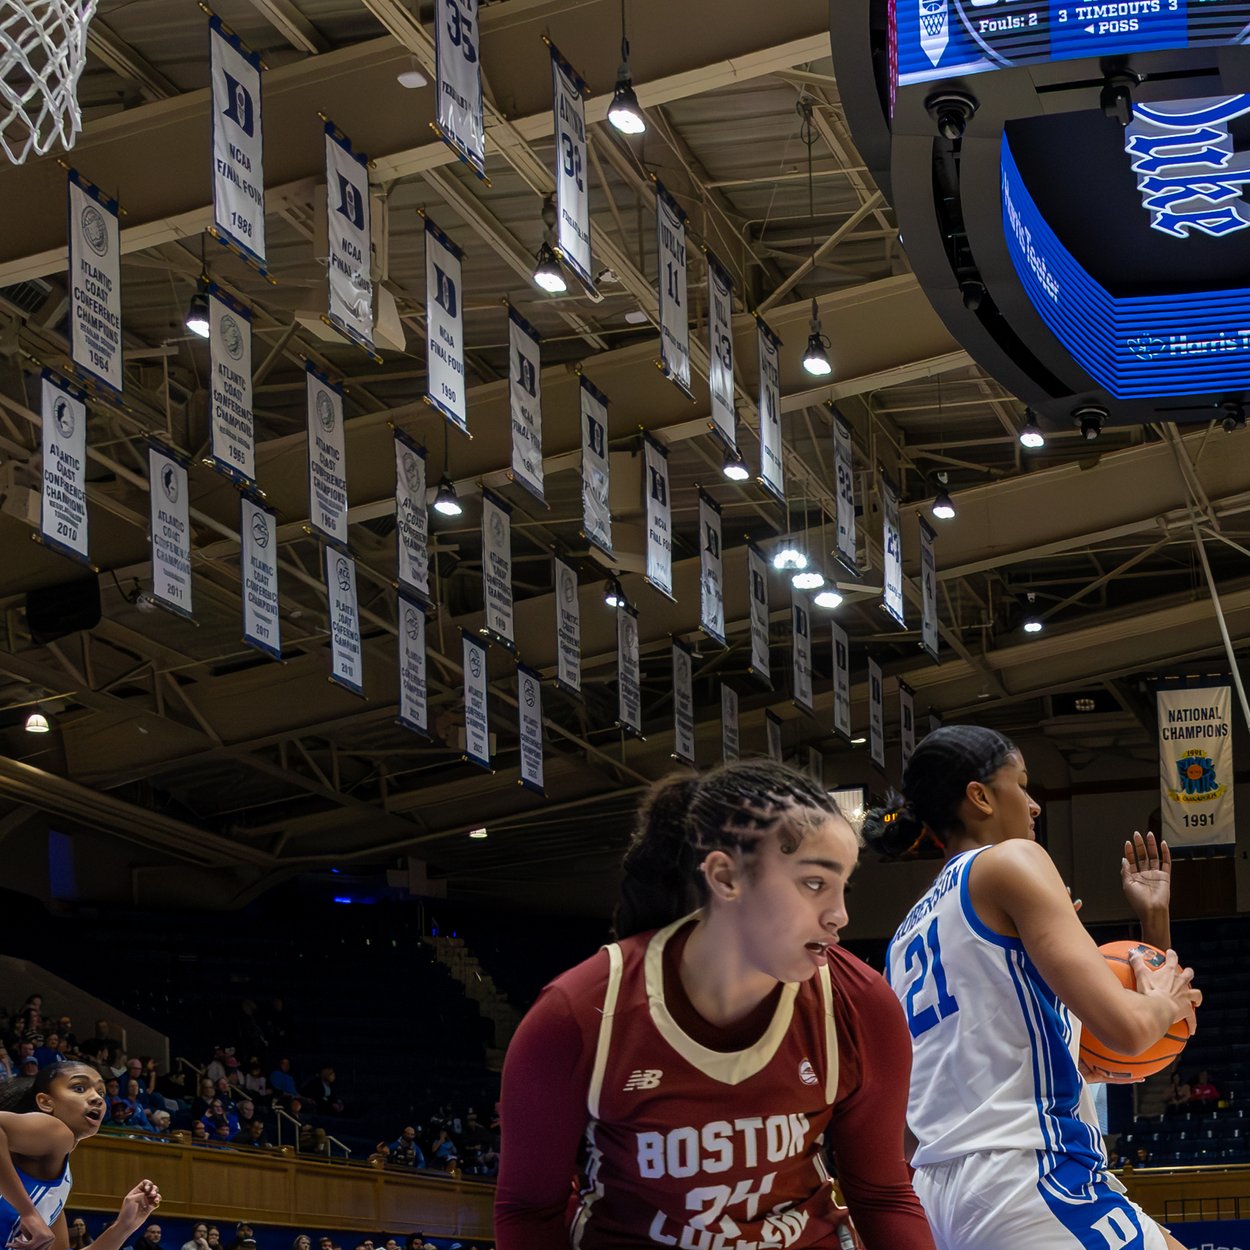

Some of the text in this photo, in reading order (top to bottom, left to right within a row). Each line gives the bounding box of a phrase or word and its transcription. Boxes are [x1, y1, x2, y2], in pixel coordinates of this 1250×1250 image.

[979, 13, 1037, 33] Fouls: 2
[1058, 0, 1178, 22] 3 TIMEOUTS 3
[446, 0, 477, 64] 35
[1098, 19, 1139, 34] POSS
[229, 142, 252, 173] NCAA
[217, 159, 263, 208] FINAL FOUR
[231, 211, 252, 238] 1988
[342, 237, 362, 265] NCAA
[81, 258, 112, 292] ATLANTIC
[667, 262, 680, 307] 11
[85, 279, 108, 304] COAST
[74, 287, 120, 330] CONFERENCE
[77, 305, 119, 344] CHAMPIONS
[439, 325, 455, 349] NCAA
[431, 339, 447, 364] FINAL
[1170, 332, 1237, 355] Harris
[218, 363, 247, 392] ATLANTIC
[224, 381, 243, 403] COAST
[57, 521, 77, 541] 2010
[167, 583, 182, 600] 2011
[1168, 706, 1221, 723] NATIONAL
[1163, 723, 1228, 740] CHAMPIONS
[1183, 813, 1215, 828] 1991
[905, 917, 959, 1038] 21
[636, 1113, 810, 1179] BOSTON
[685, 1171, 778, 1231] 24
